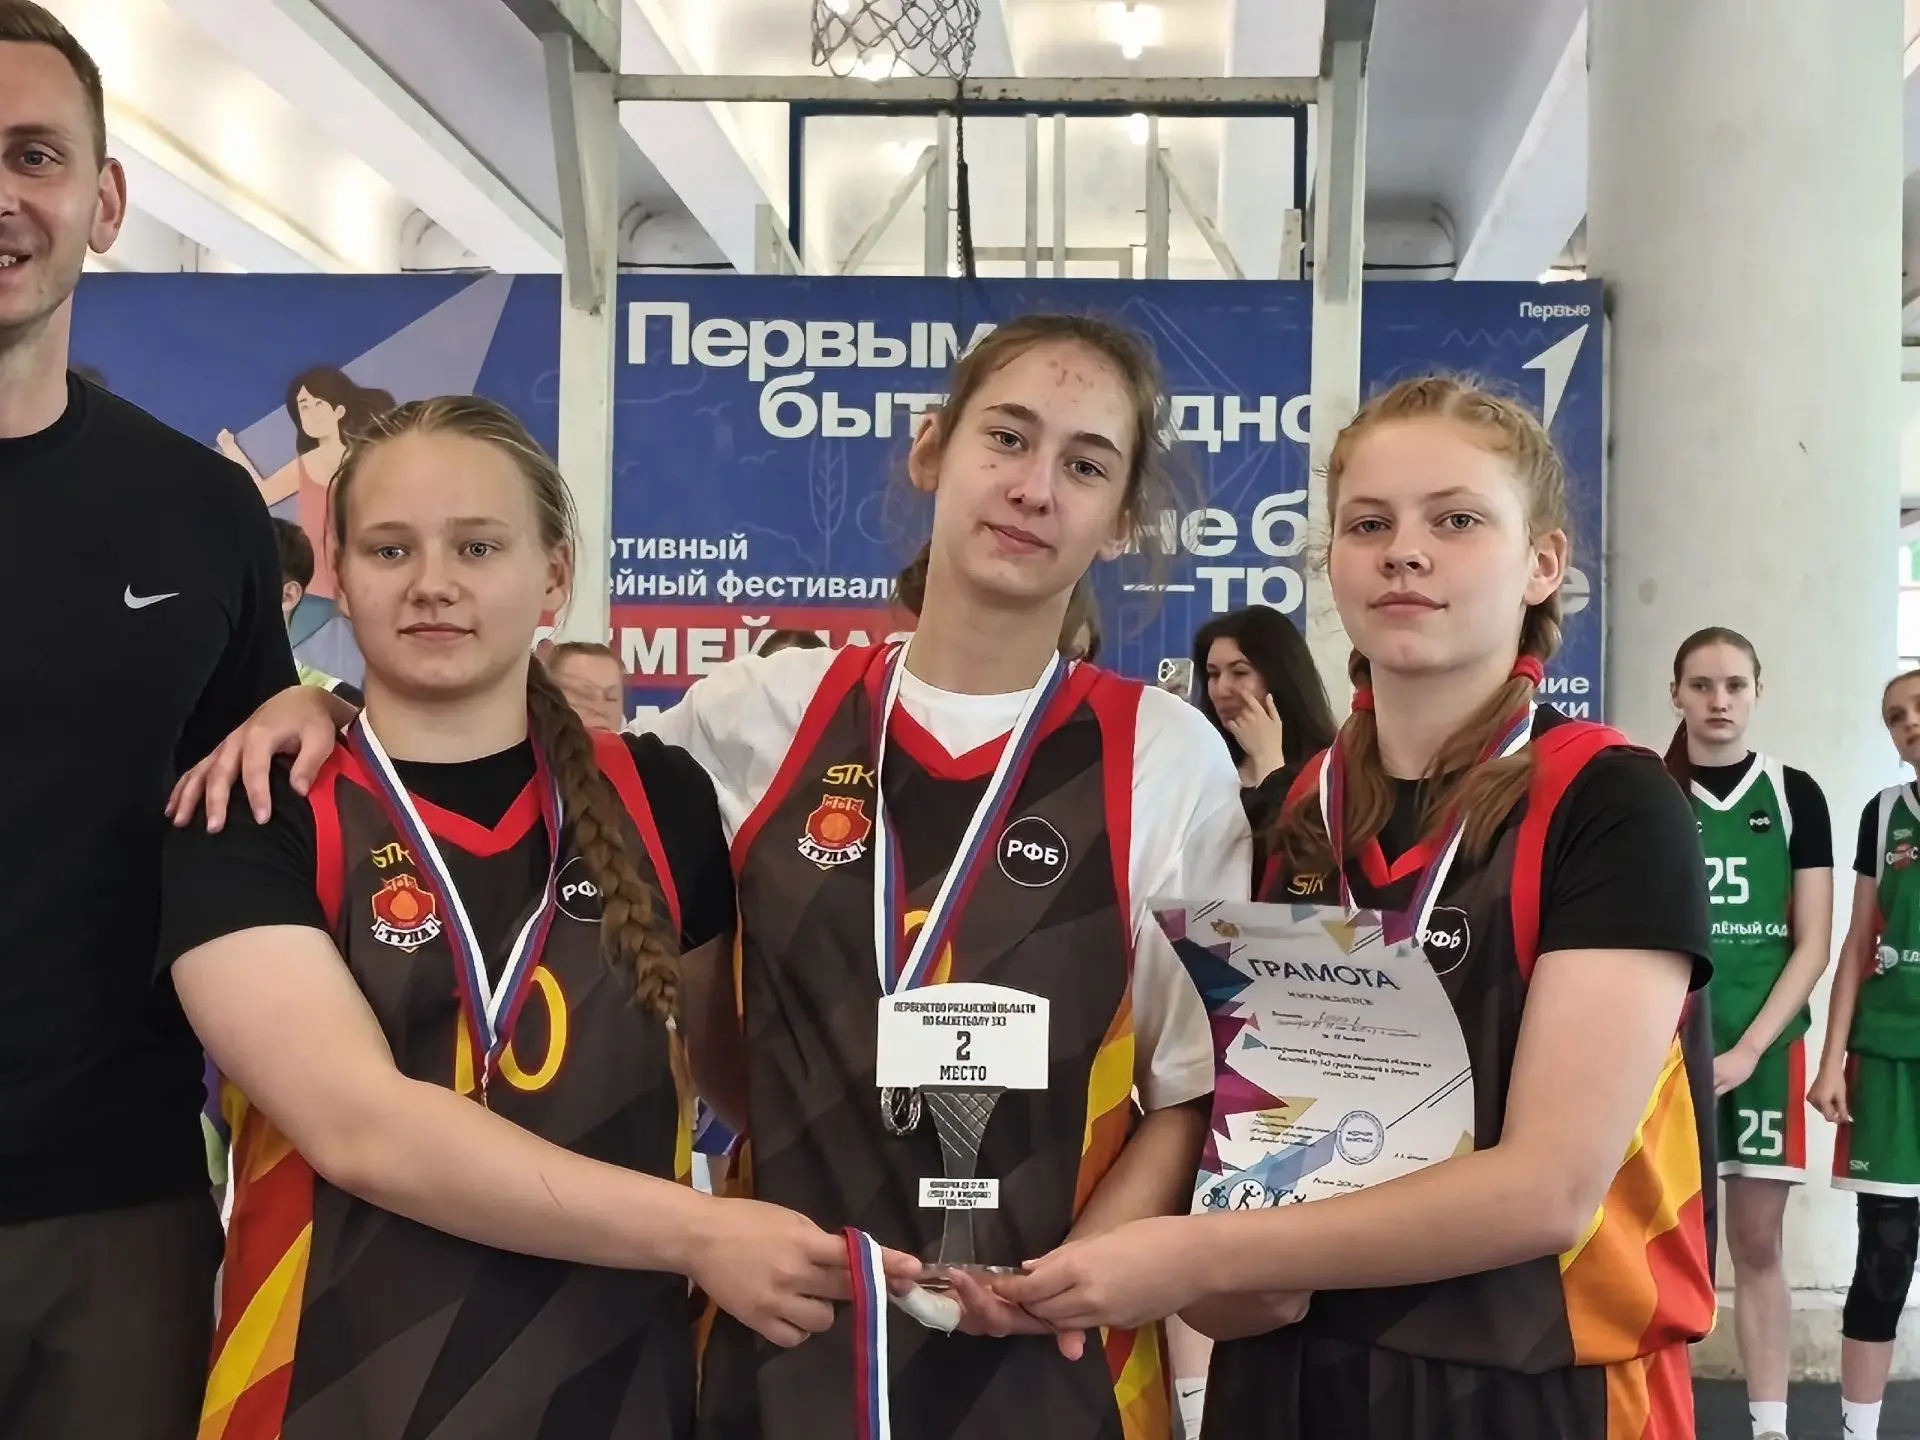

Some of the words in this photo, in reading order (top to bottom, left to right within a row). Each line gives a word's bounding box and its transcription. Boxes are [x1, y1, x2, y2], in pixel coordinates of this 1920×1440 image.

[1519, 301, 1591, 322] Первые
[627, 301, 998, 382] Первым
[758, 370, 950, 439] быт
[1156, 394, 1311, 453] дно
[610, 532, 748, 561] тивный
[608, 568, 707, 597] йный
[1006, 839, 1060, 866] РФБ
[562, 880, 604, 901] РФ
[1703, 856, 1750, 905] 25
[1711, 920, 1763, 935] ЛЁНЫЙ
[1246, 958, 1401, 991] ГРАМОТА
[956, 1030, 972, 1061] 2
[939, 1065, 987, 1081] МЕСТО
[1737, 1109, 1783, 1157] 25
